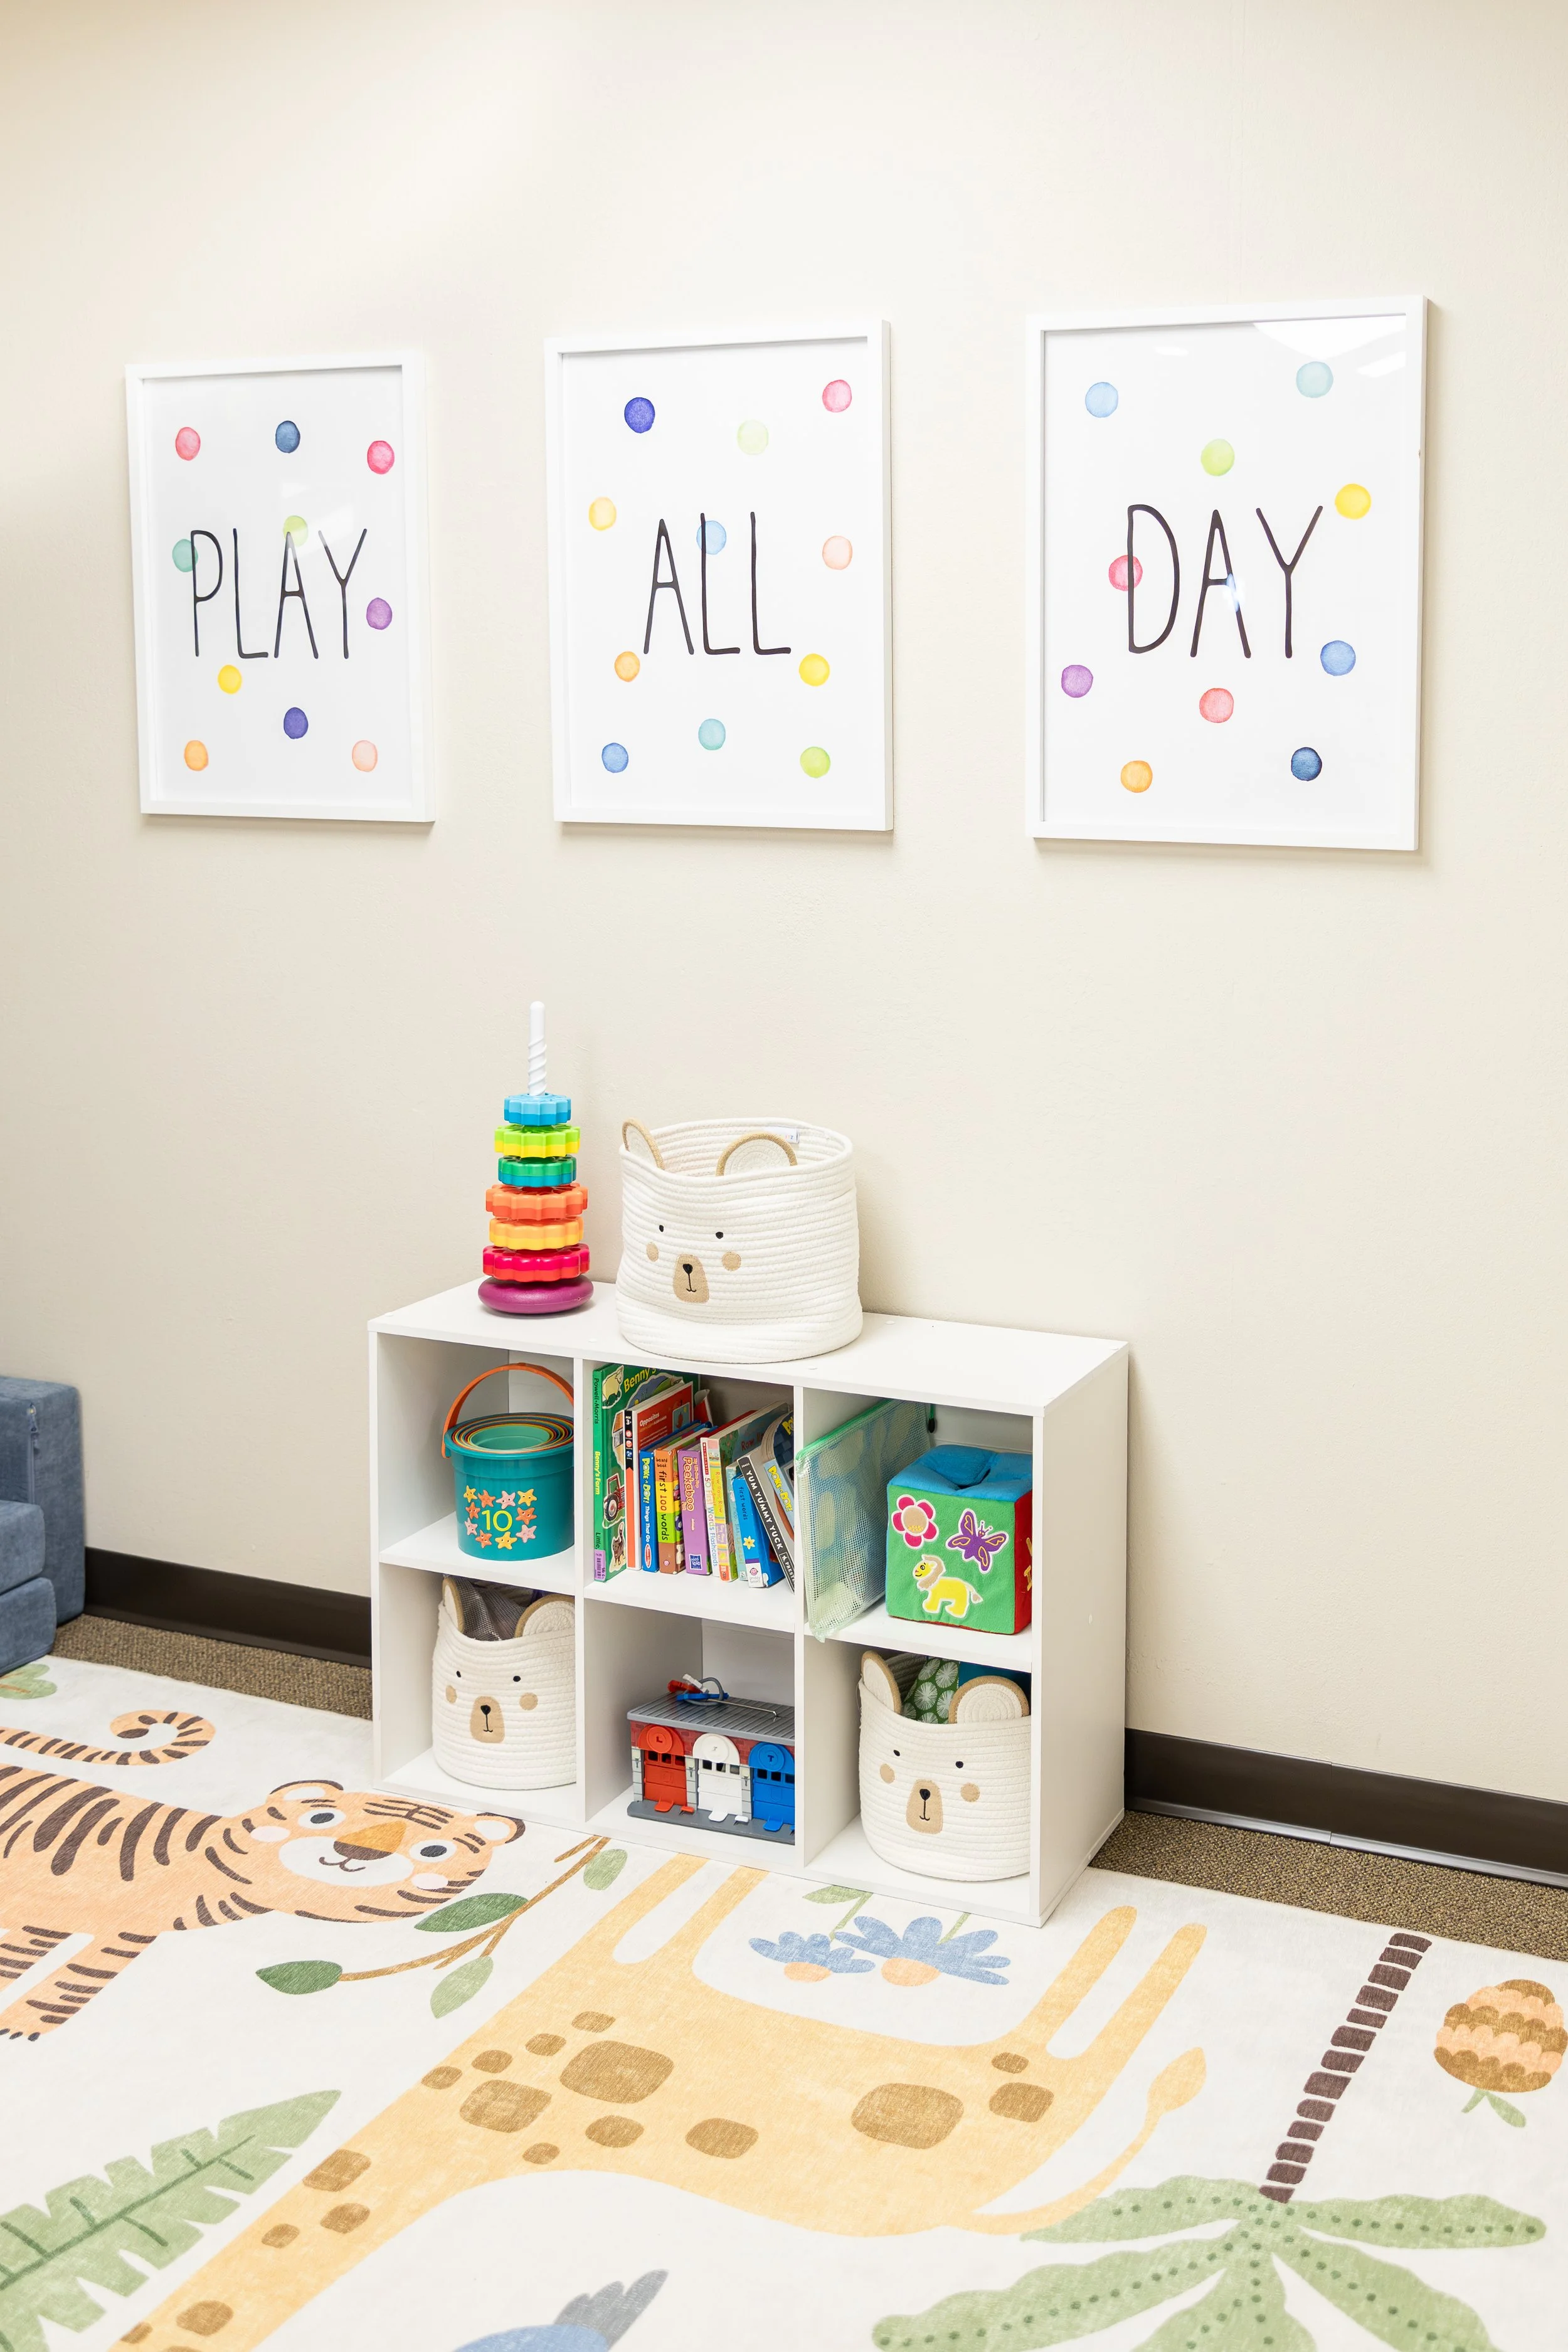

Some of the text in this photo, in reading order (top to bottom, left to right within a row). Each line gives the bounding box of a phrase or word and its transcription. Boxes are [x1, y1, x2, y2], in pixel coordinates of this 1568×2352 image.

[190, 527, 368, 659] PLAY
[642, 511, 792, 655] ALL
[1126, 504, 1324, 659] DAY
[659, 1471, 667, 1492] first
[682, 1457, 695, 1511] Peekaboo
[704, 1477, 711, 1488] 50
[481, 1510, 512, 1532] 10
[707, 1507, 715, 1530] Words
[746, 1470, 783, 1550] YUM YUMMY YUCK
[645, 1535, 650, 1543] Go
[661, 1513, 669, 1540] words
[709, 1533, 718, 1567] Flashcards
